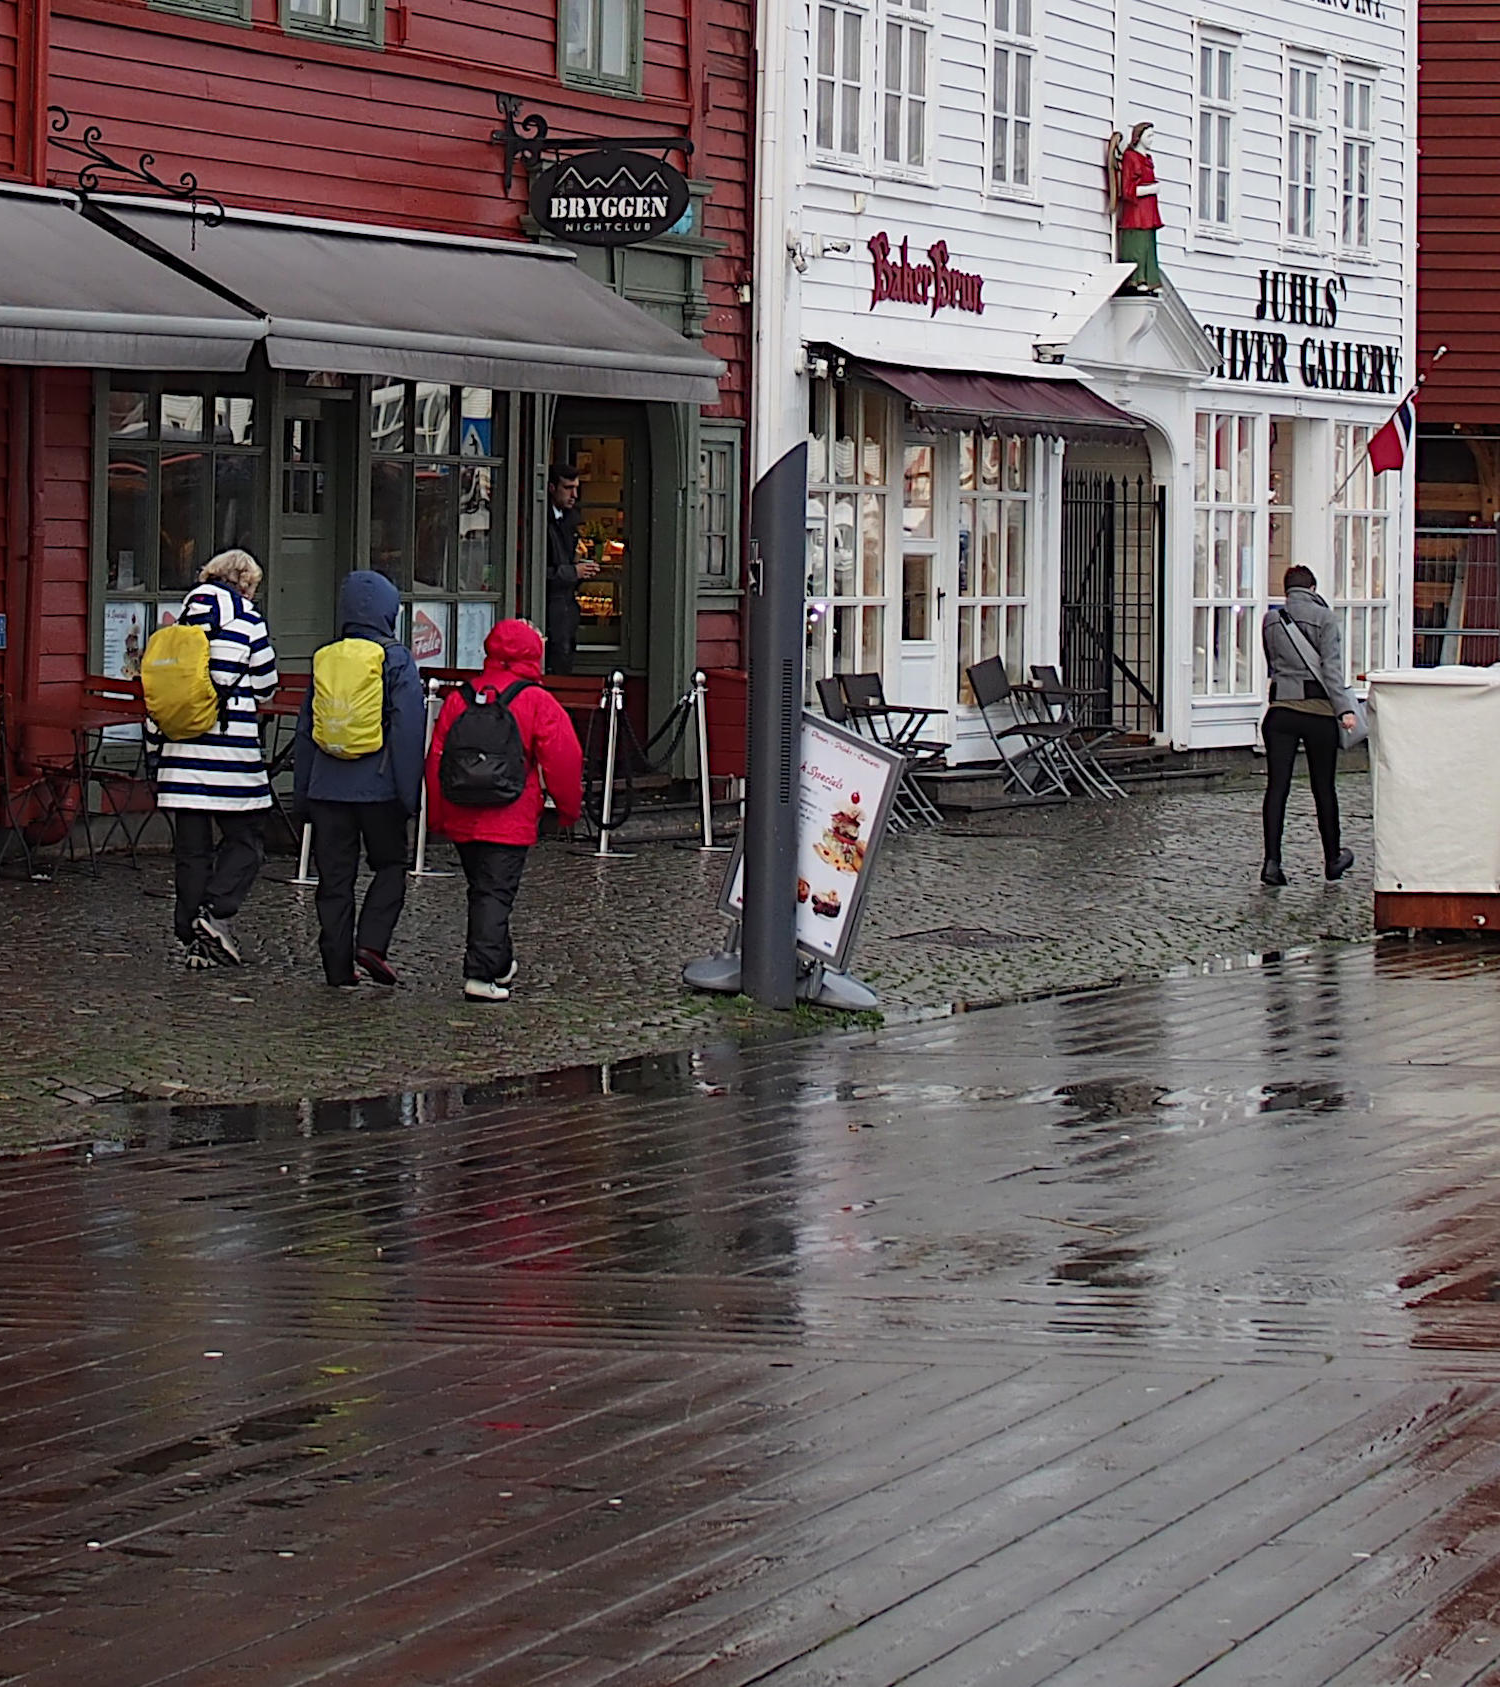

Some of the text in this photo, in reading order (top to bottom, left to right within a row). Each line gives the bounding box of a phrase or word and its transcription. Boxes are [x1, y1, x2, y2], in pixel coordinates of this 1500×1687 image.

[550, 196, 669, 219] BRYGGEN
[565, 222, 651, 232] NIGHTCLUB
[867, 231, 931, 312] Baker
[1301, 337, 1398, 394] GALLERY
